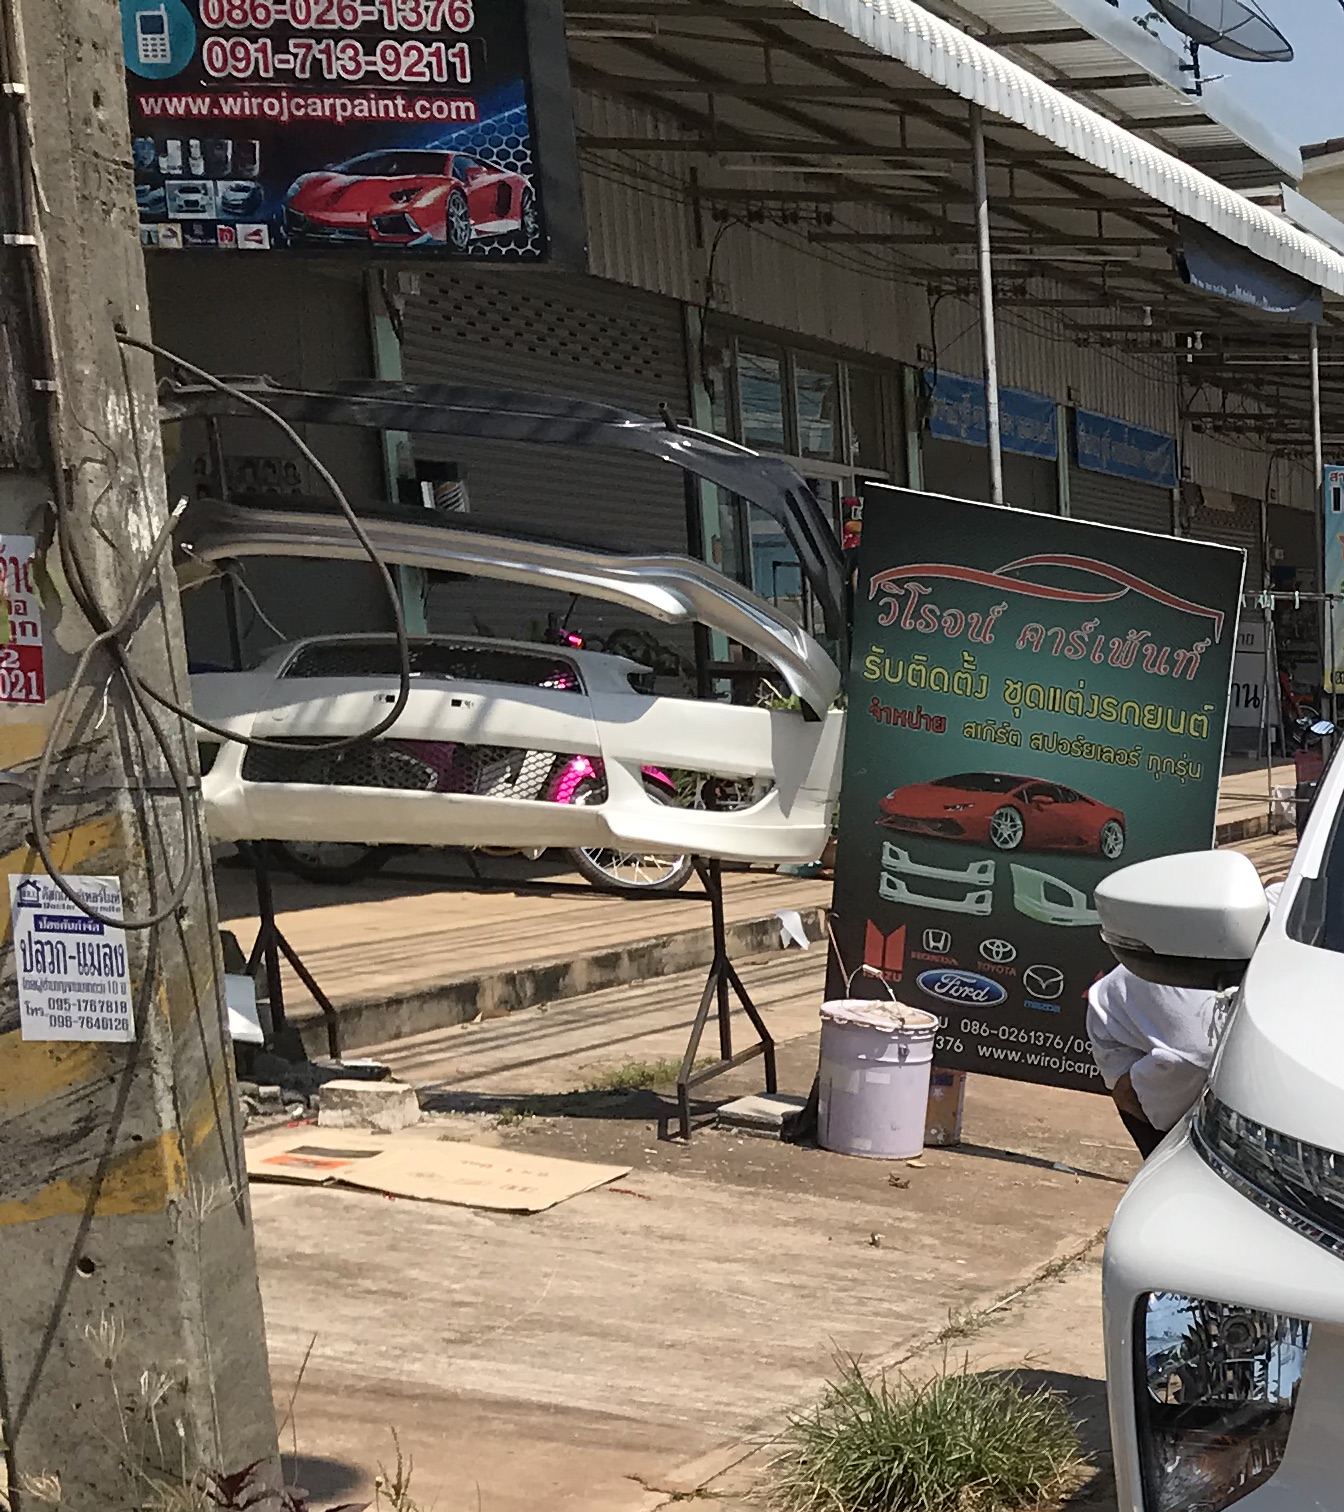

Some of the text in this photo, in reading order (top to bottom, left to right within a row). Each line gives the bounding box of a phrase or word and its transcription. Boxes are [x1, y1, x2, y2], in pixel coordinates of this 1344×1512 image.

[200, 0, 475, 32] 086-026-1376
[203, 37, 472, 83] 091-713-9211
[139, 91, 477, 125] www.wirojcarpaint.com
[878, 581, 1008, 644] วิโรจน์
[863, 646, 1214, 740] รับติดตั้ง ชุดแต่งรถยนต์
[21, 930, 126, 978] ปลวก-แมลง
[977, 960, 1018, 977] TOYOTA
[934, 973, 991, 1003] Ford
